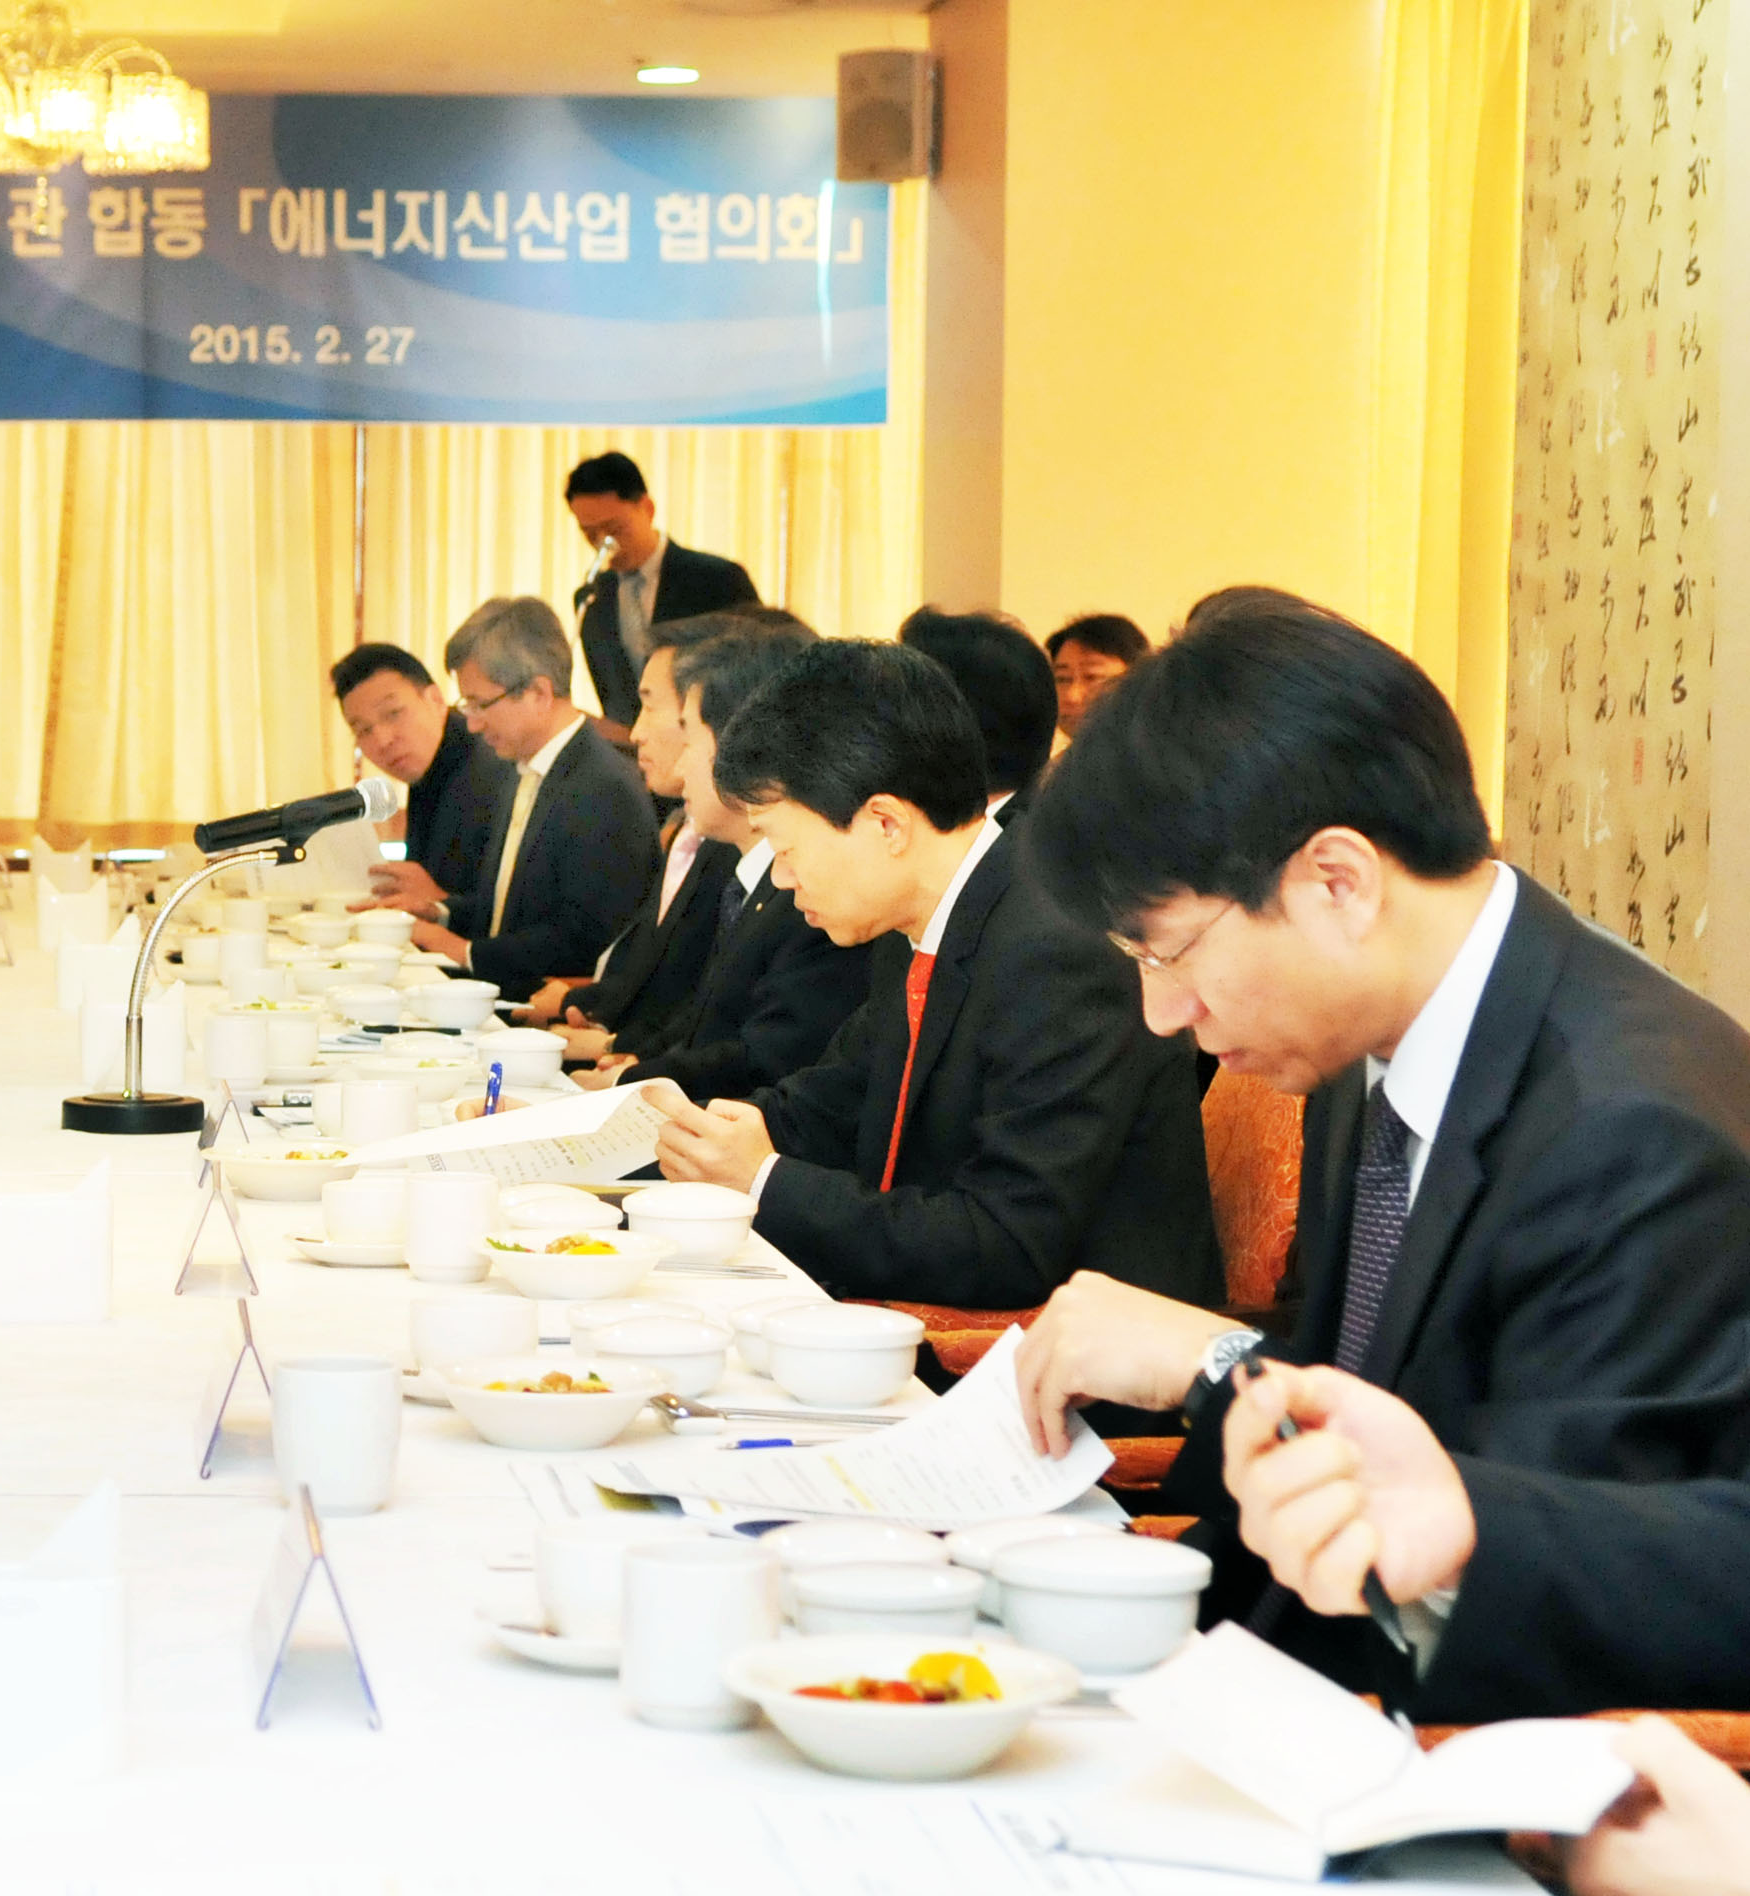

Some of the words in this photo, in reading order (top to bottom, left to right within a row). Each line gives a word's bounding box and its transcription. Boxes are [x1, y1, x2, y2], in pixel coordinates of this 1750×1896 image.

[87, 187, 208, 258] 합동
[190, 324, 303, 364] 2015.
[314, 325, 351, 364] 2.
[365, 325, 416, 364] 27
